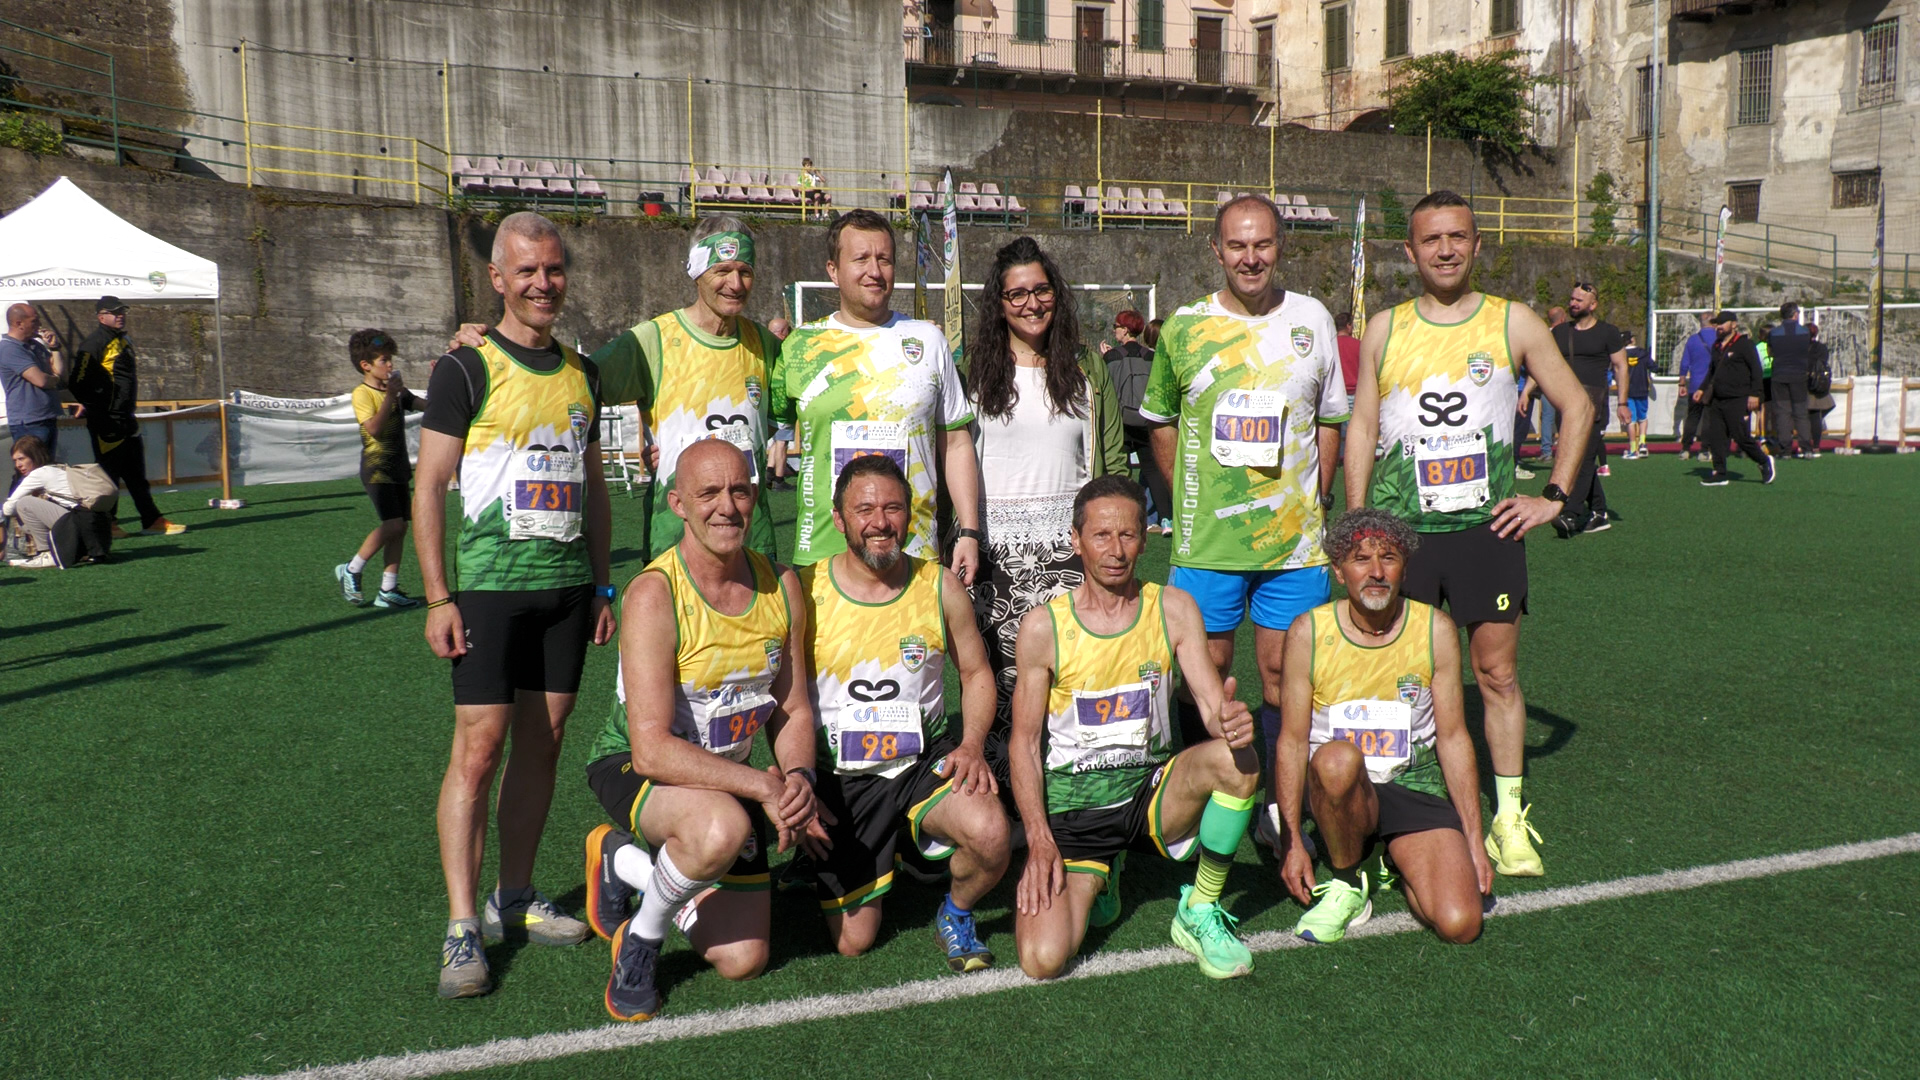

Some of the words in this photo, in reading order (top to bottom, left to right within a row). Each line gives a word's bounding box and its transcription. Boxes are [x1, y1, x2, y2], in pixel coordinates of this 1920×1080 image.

[21, 278, 66, 287] ANGOLO
[68, 278, 101, 286] TERME
[104, 278, 133, 286] A.S.D.
[1227, 417, 1270, 441] 100
[802, 455, 815, 507] ANGOLO
[1183, 454, 1200, 509] ANGOLO
[1427, 457, 1475, 485] 870
[527, 483, 573, 510] 731
[798, 511, 815, 552] TERME
[1095, 695, 1131, 723] 94
[729, 710, 759, 742] 96
[862, 733, 898, 760] 98
[1345, 731, 1395, 756] 102
